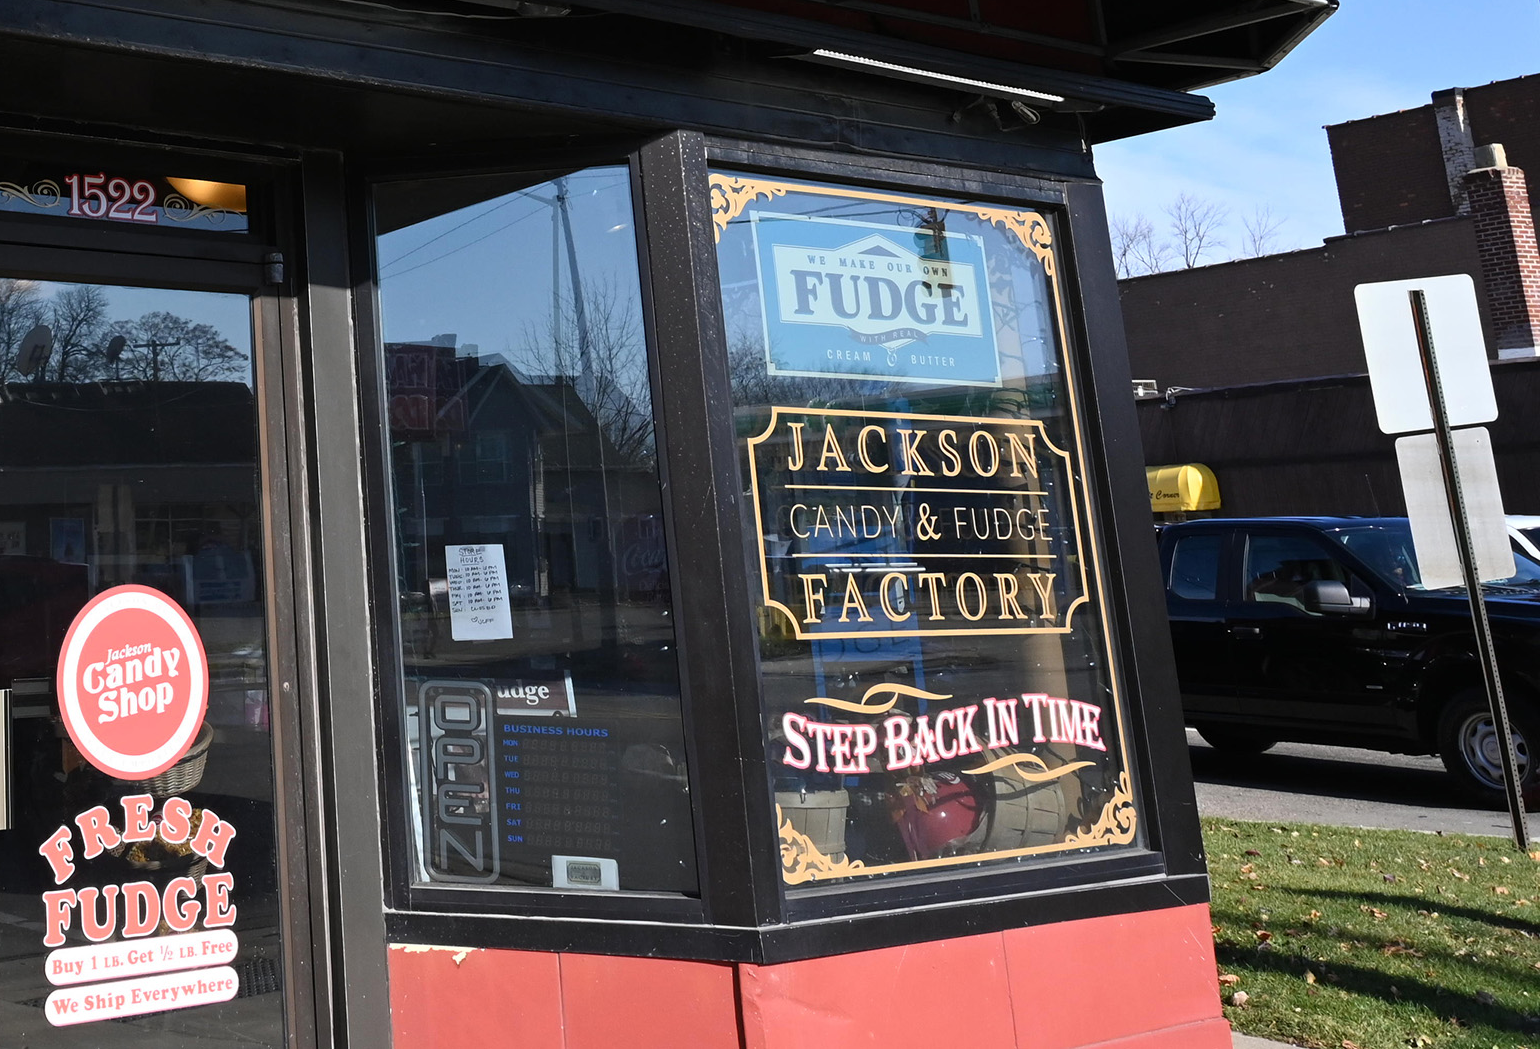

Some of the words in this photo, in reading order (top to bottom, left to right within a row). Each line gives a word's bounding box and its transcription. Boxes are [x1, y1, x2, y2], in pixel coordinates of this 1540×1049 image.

[65, 172, 159, 224] 1522
[807, 255, 826, 266] WE
[839, 258, 876, 270] MAKE
[887, 262, 912, 273] OUR
[923, 266, 948, 277] OWN
[790, 269, 969, 328] FUDGE
[860, 334, 886, 343] WITH
[892, 331, 918, 340] REAL
[826, 349, 871, 362] CREAM
[911, 354, 955, 367] BUTTER
[787, 422, 1039, 479] JACKSON
[790, 503, 900, 540] CANDY
[916, 502, 942, 541] &
[954, 506, 1053, 542] FUDGE
[798, 572, 1057, 624] FACTORY
[105, 643, 152, 665] Jackson
[83, 647, 180, 694] Candy
[98, 682, 174, 724] Shop
[493, 679, 550, 706] udge
[502, 739, 519, 747] MON
[503, 724, 563, 736] BUSINESS
[566, 728, 609, 738] HOURS
[782, 712, 877, 774] STEP
[884, 705, 984, 771] BACK
[983, 698, 1019, 749] IN
[1021, 693, 1107, 752] TIME
[503, 755, 519, 763] TUE
[434, 695, 484, 871] OPEN
[504, 771, 520, 779] WED
[505, 787, 520, 795] THU
[506, 803, 521, 811] FRI
[38, 793, 238, 884] FRESH
[507, 819, 522, 827] SAT
[508, 835, 523, 843] SUN
[42, 871, 238, 947] FUDGE
[52, 959, 84, 976] Buy
[91, 956, 97, 970] 1
[104, 955, 124, 968] LB.
[127, 950, 154, 965] Get
[180, 946, 197, 959] LB.
[202, 941, 233, 956] Free
[52, 998, 79, 1015] We
[84, 992, 125, 1010] Ship
[131, 978, 233, 1004] Everywhere
